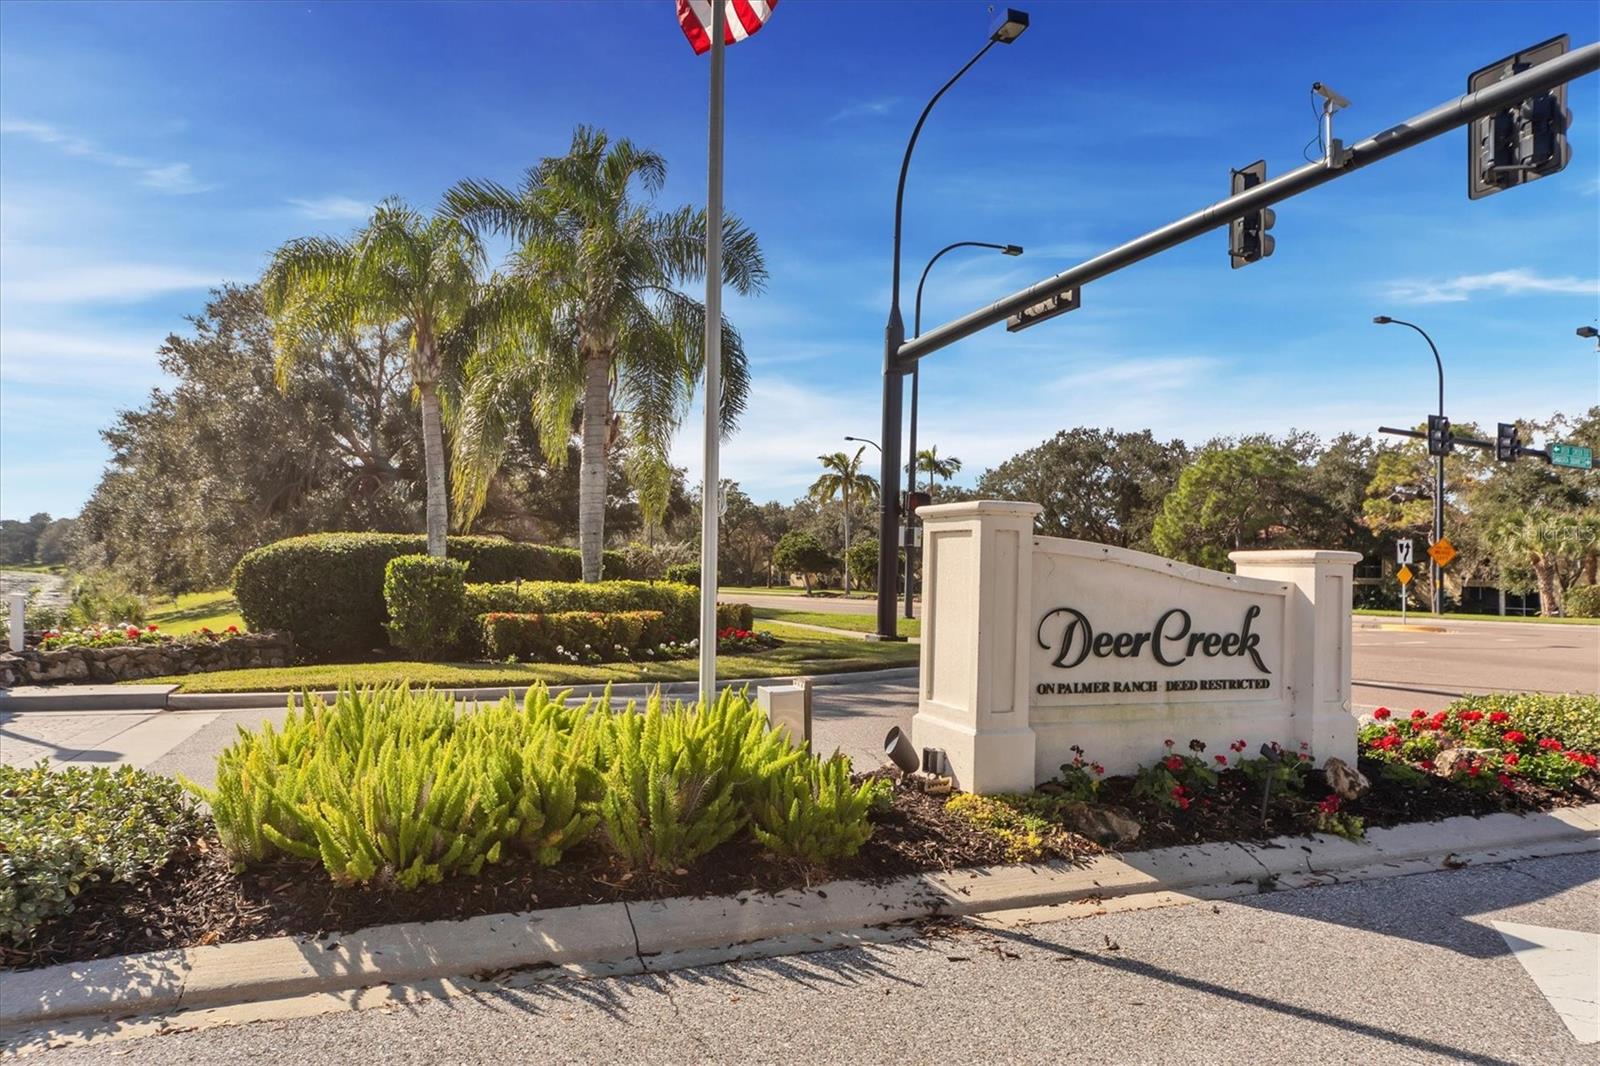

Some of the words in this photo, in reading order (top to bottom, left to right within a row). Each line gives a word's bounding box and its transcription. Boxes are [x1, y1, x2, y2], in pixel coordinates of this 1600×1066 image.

[1037, 607, 1151, 669] Deer
[1151, 605, 1272, 674] Creek
[1036, 683, 1055, 695] ON
[1057, 681, 1110, 694] PALMER
[1113, 680, 1158, 693] RANCH
[1165, 680, 1198, 692] DEED
[1200, 678, 1270, 691] RESTRICTED
